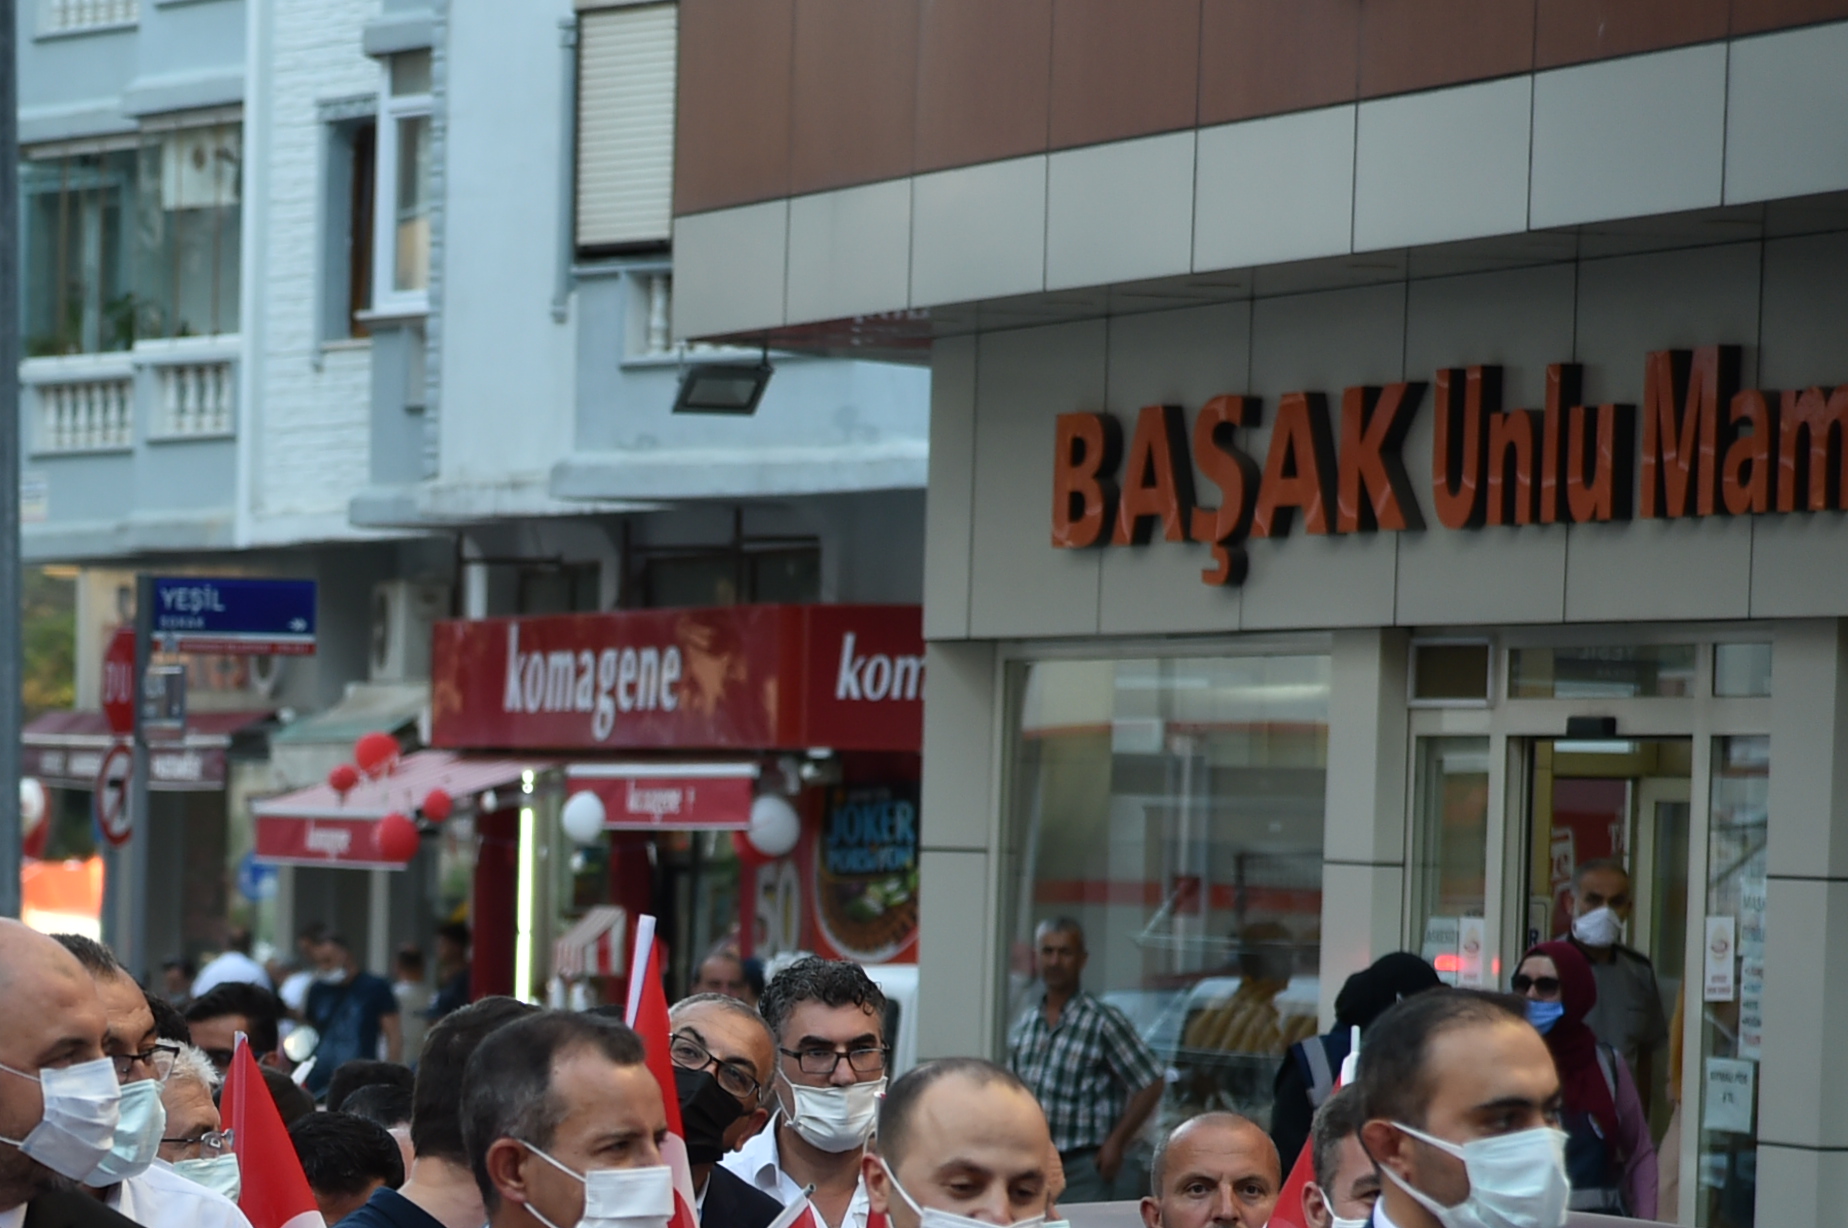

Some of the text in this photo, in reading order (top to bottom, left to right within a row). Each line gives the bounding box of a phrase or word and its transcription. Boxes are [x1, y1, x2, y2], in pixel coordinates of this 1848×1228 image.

[1051, 344, 1848, 586] BAŞAK Unlu Mam
[159, 584, 226, 615] YEŞİL
[503, 623, 682, 742] komagene
[836, 632, 925, 702] kom
[825, 801, 916, 847] JOKER
